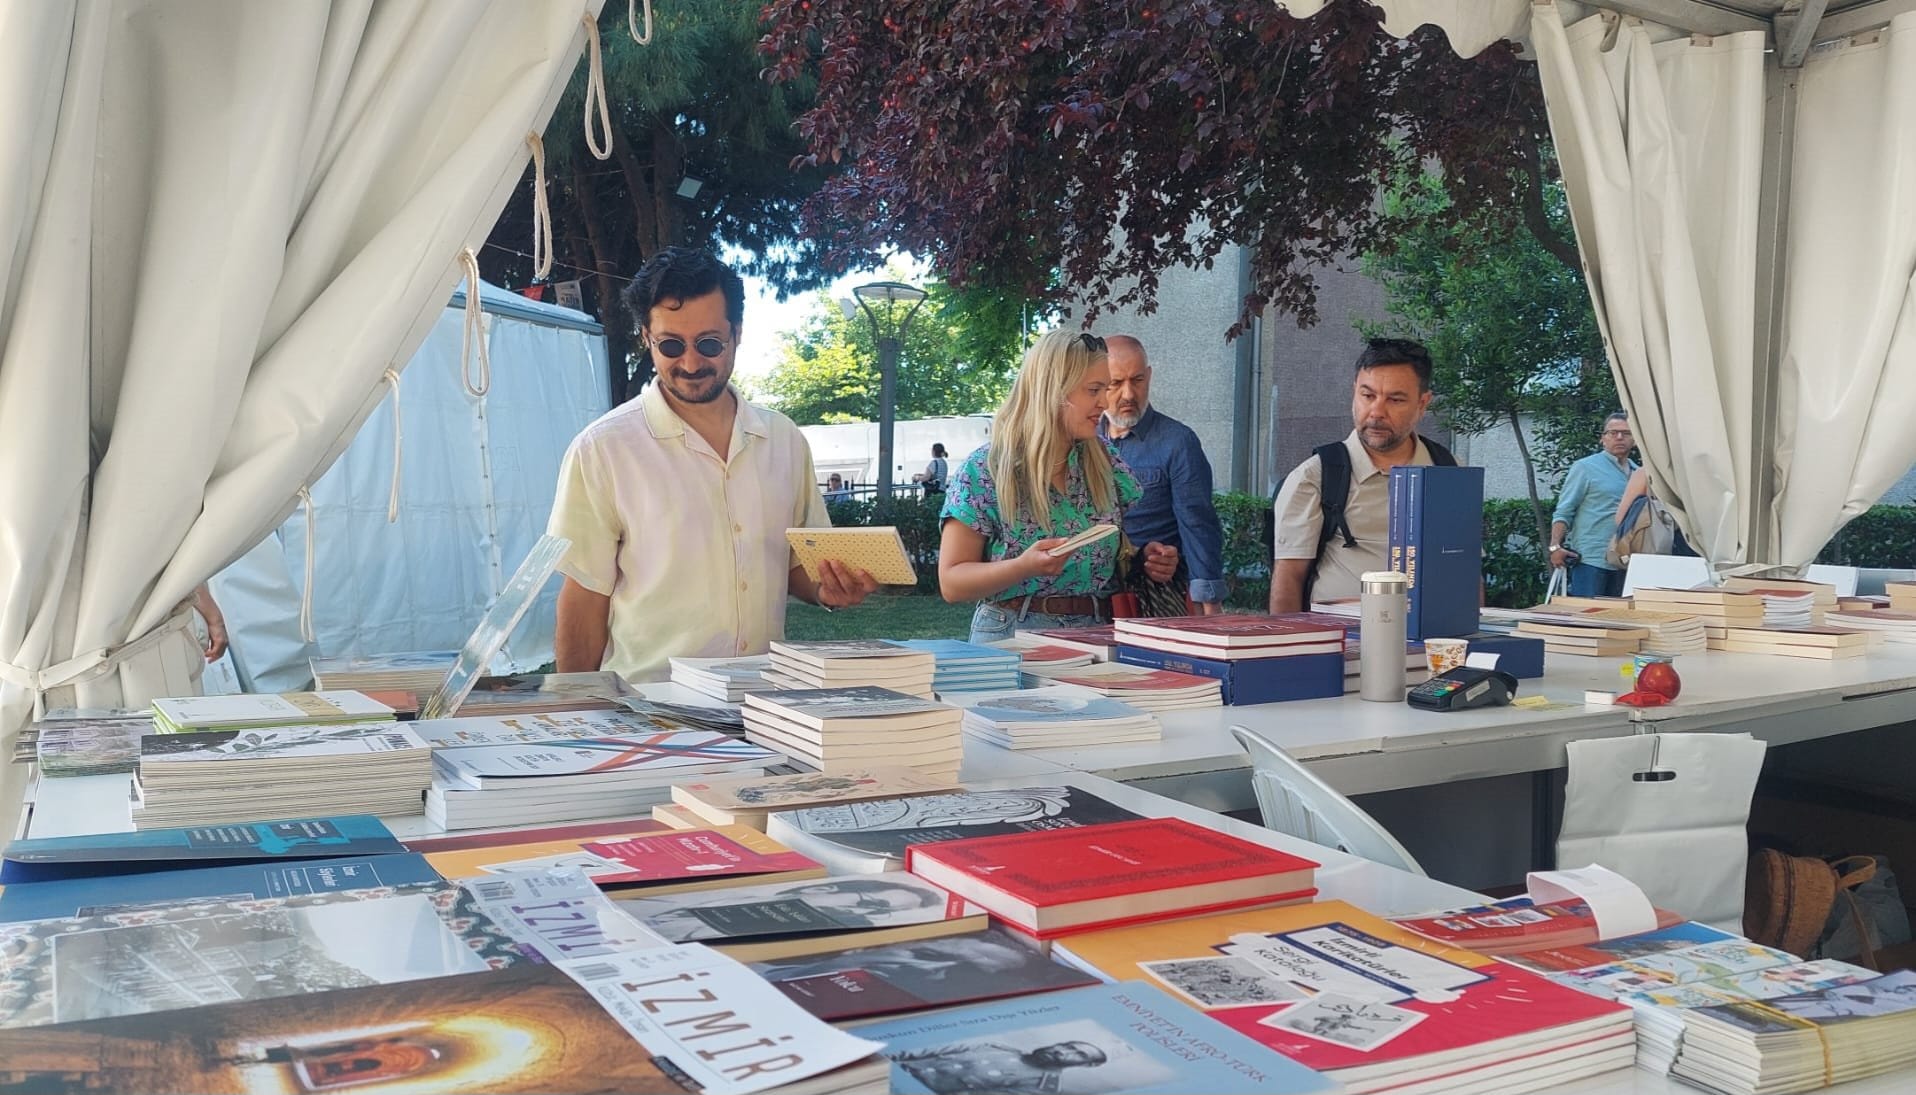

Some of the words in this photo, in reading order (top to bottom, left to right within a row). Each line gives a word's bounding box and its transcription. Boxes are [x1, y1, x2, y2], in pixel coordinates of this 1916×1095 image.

[1254, 948, 1328, 982] Kataloğu
[1273, 945, 1320, 965] Sergi
[1312, 939, 1411, 980] Karikatürler
[621, 971, 804, 1082] İZMİR
